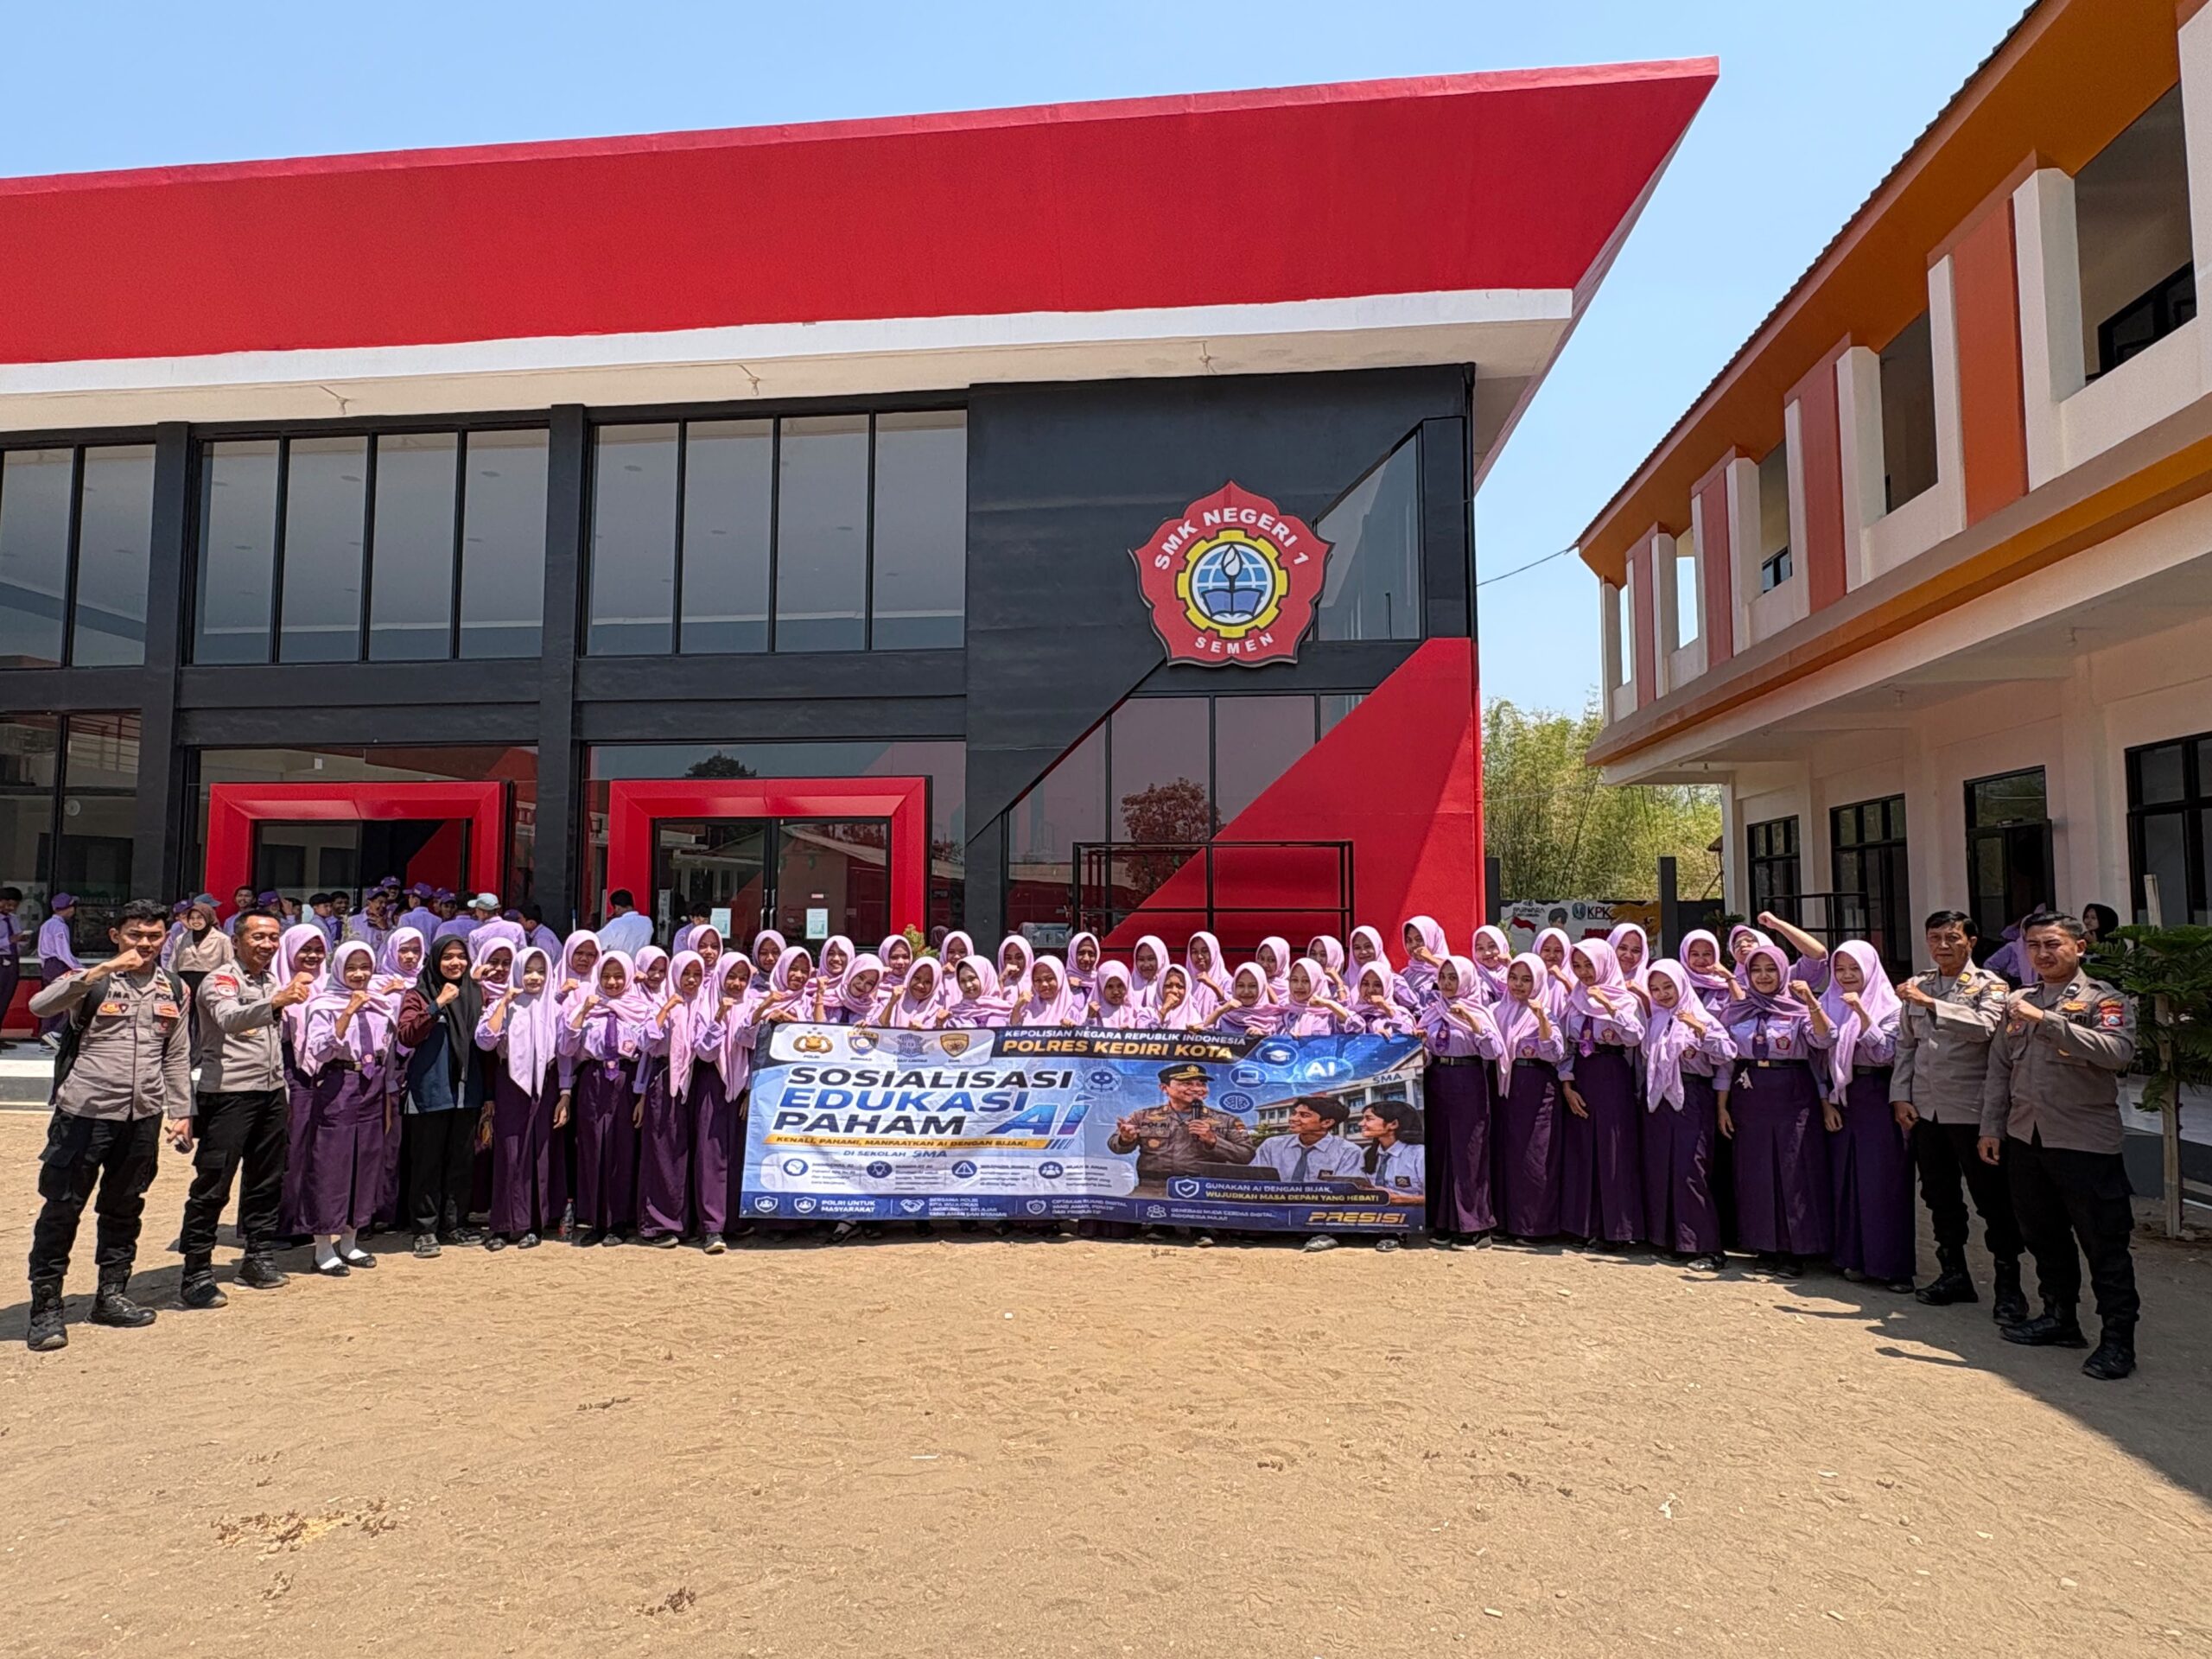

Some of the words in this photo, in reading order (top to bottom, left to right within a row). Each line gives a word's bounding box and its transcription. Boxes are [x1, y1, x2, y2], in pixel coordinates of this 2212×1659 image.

[1154, 519, 1199, 570] SMK
[1202, 507, 1298, 548] NEGERI
[1294, 552, 1309, 567] 1
[1195, 632, 1274, 654] SEMEN
[1587, 906, 1612, 919] KPK
[107, 990, 130, 1000] IMA
[1004, 1029, 1072, 1038] KEPOLISIAN
[1075, 1030, 1122, 1039] NEGARA
[1124, 1033, 1179, 1041] REPUBLIK
[1182, 1034, 1246, 1046] INDONESIA
[1002, 1039, 1088, 1052] POLRES
[1093, 1042, 1169, 1056] KEDIRI
[1174, 1045, 1232, 1058] KOTA
[1306, 1061, 1336, 1077] AI
[788, 1066, 1073, 1089] SOSIALISASI
[1373, 1072, 1402, 1084] SMA
[779, 1087, 1030, 1112] EDUKASI
[772, 1111, 966, 1135] PAHAM
[776, 1136, 817, 1145] KENALI,
[1205, 1182, 1250, 1191] GUNAKAN
[1205, 1191, 1257, 1200] WUJUDKAN
[1308, 1211, 1407, 1224] PRESISI
